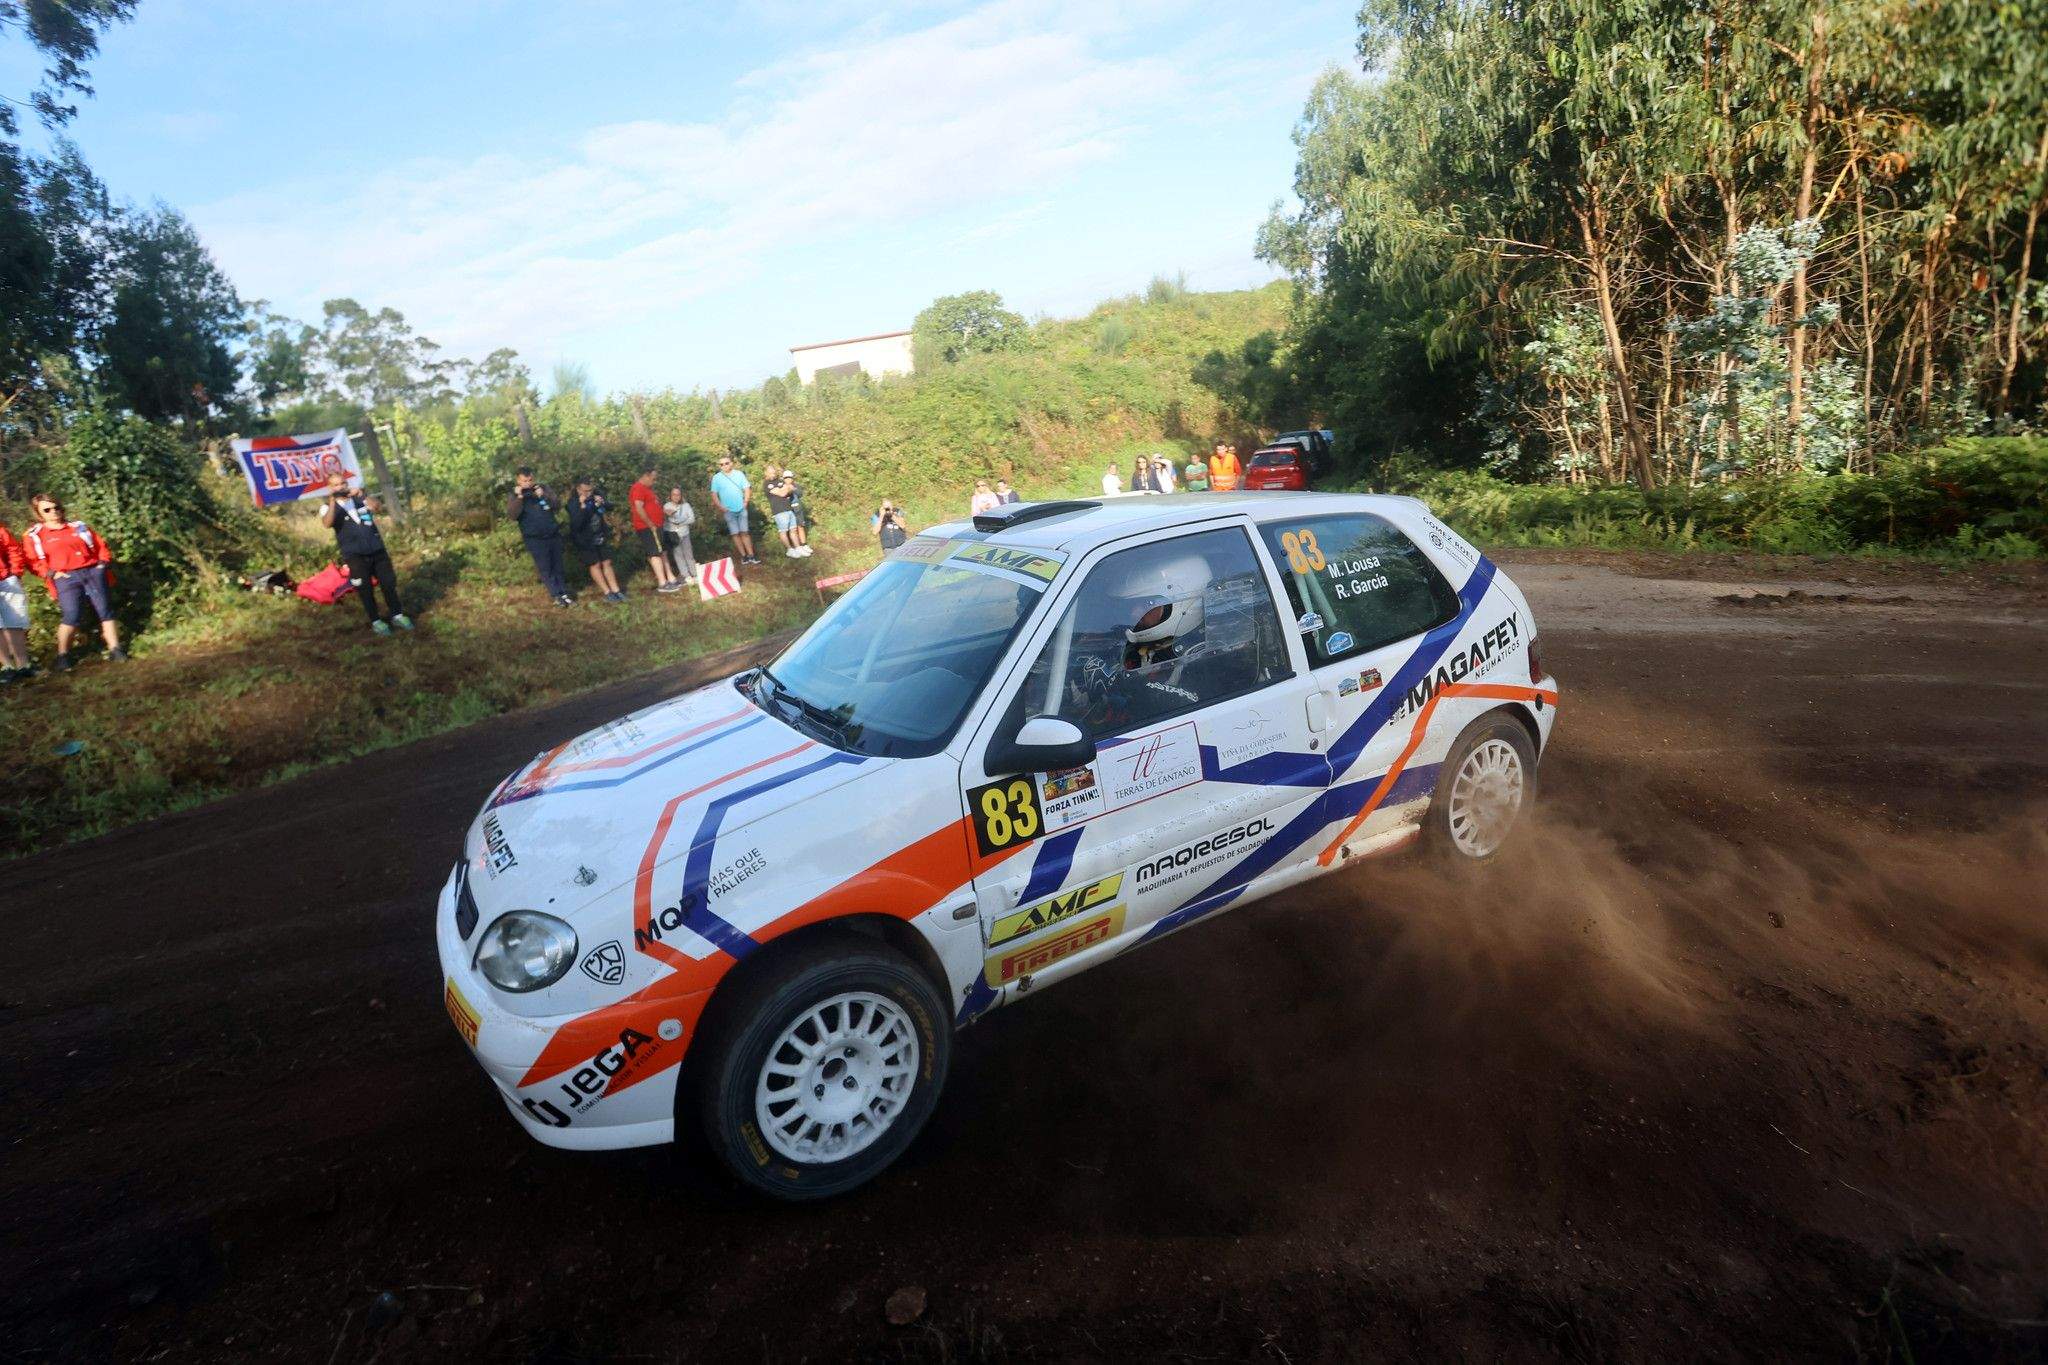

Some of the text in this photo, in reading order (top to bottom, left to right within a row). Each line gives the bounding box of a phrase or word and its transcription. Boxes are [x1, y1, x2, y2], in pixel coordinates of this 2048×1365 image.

[1281, 528, 1326, 574] 83
[1327, 556, 1381, 579] M. Lousa
[1334, 573, 1389, 600] R. García
[1406, 610, 1520, 714] MAGAFEY
[1475, 640, 1521, 680] NEUMATICOS
[1045, 800, 1071, 815] FORZA
[1115, 783, 1145, 800] TERRAS
[1145, 779, 1157, 790] DE
[981, 780, 1038, 846] 83
[713, 857, 767, 898] PALIERES
[735, 848, 762, 869] QUE
[1137, 872, 1183, 896] MAQUINARIA
[1184, 869, 1190, 877] Y
[1190, 854, 1226, 875] REPUESTOS
[1226, 850, 1235, 860] DE
[1013, 882, 1101, 935] AMF
[1001, 917, 1111, 981] PIRELLI
